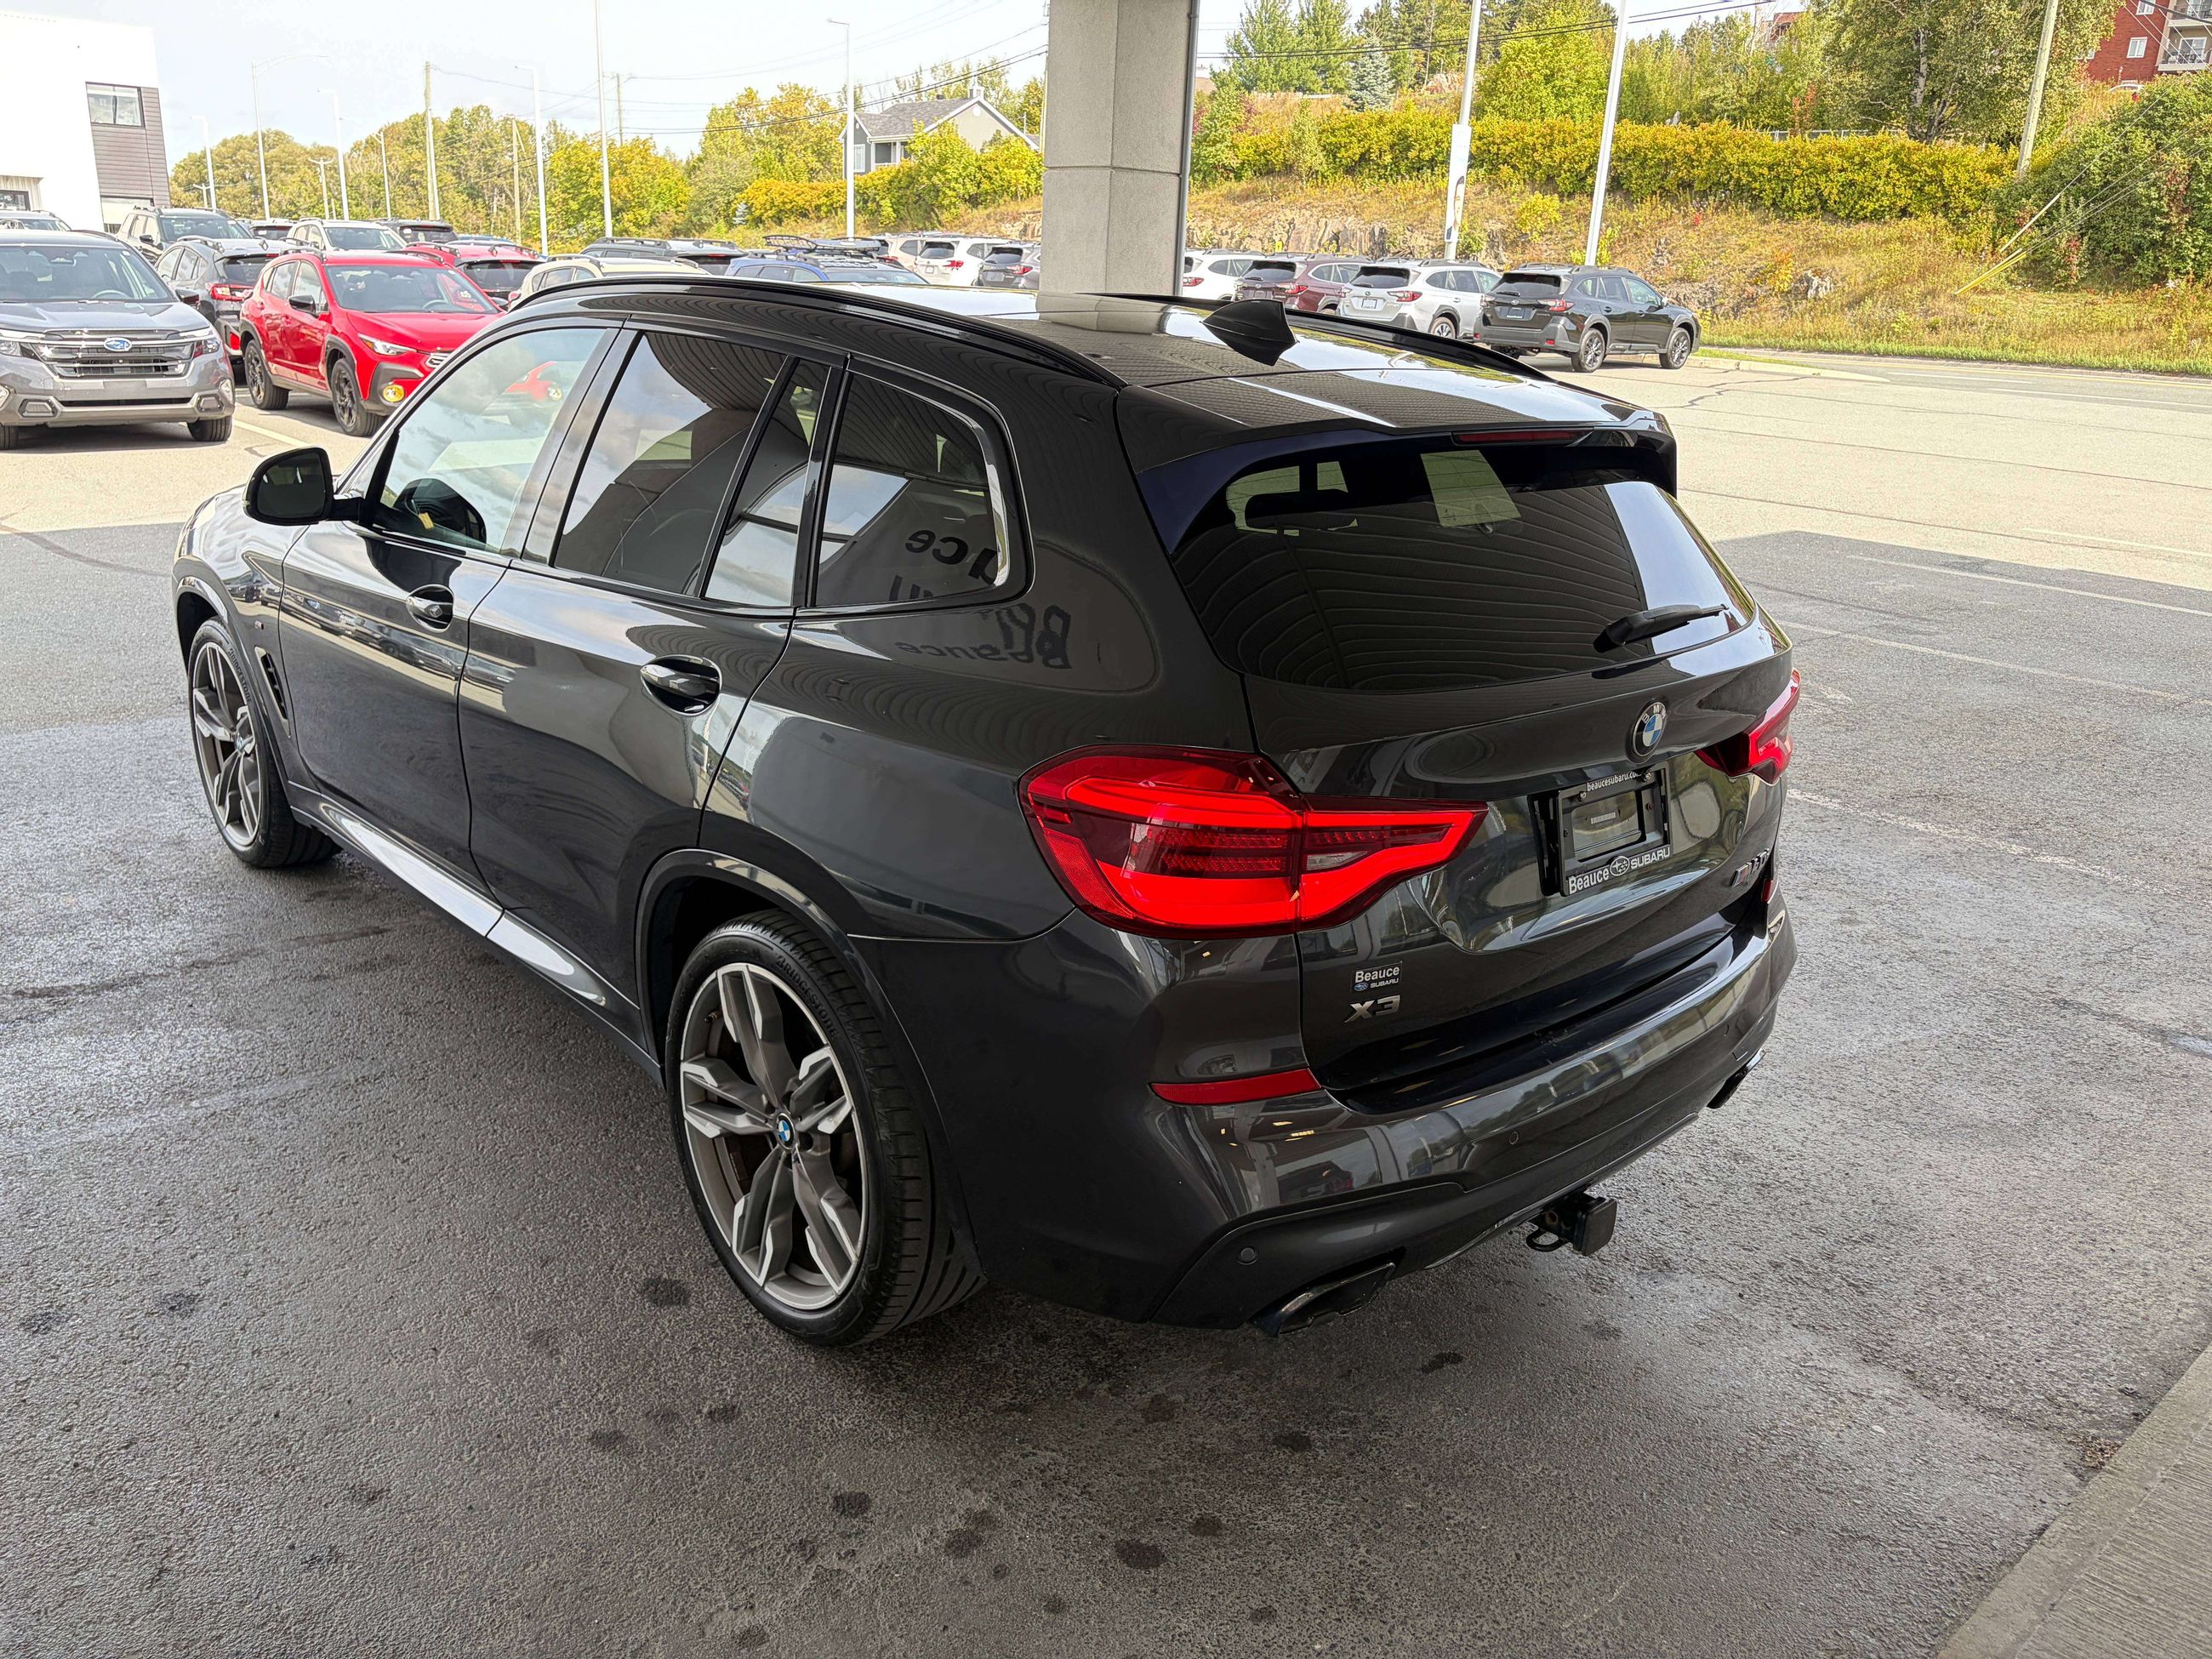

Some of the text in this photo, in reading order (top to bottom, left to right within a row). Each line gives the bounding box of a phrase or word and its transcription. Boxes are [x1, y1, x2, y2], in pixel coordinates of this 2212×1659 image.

[1587, 772, 1642, 791] beaucesubaru.co
[1569, 847, 1670, 894] Beauce SUBARU
[1354, 966, 1400, 983] Beauce
[1370, 978, 1400, 988] SUBARU
[775, 955, 840, 1039] BRIDGESTONE
[1344, 995, 1400, 1023] X3
